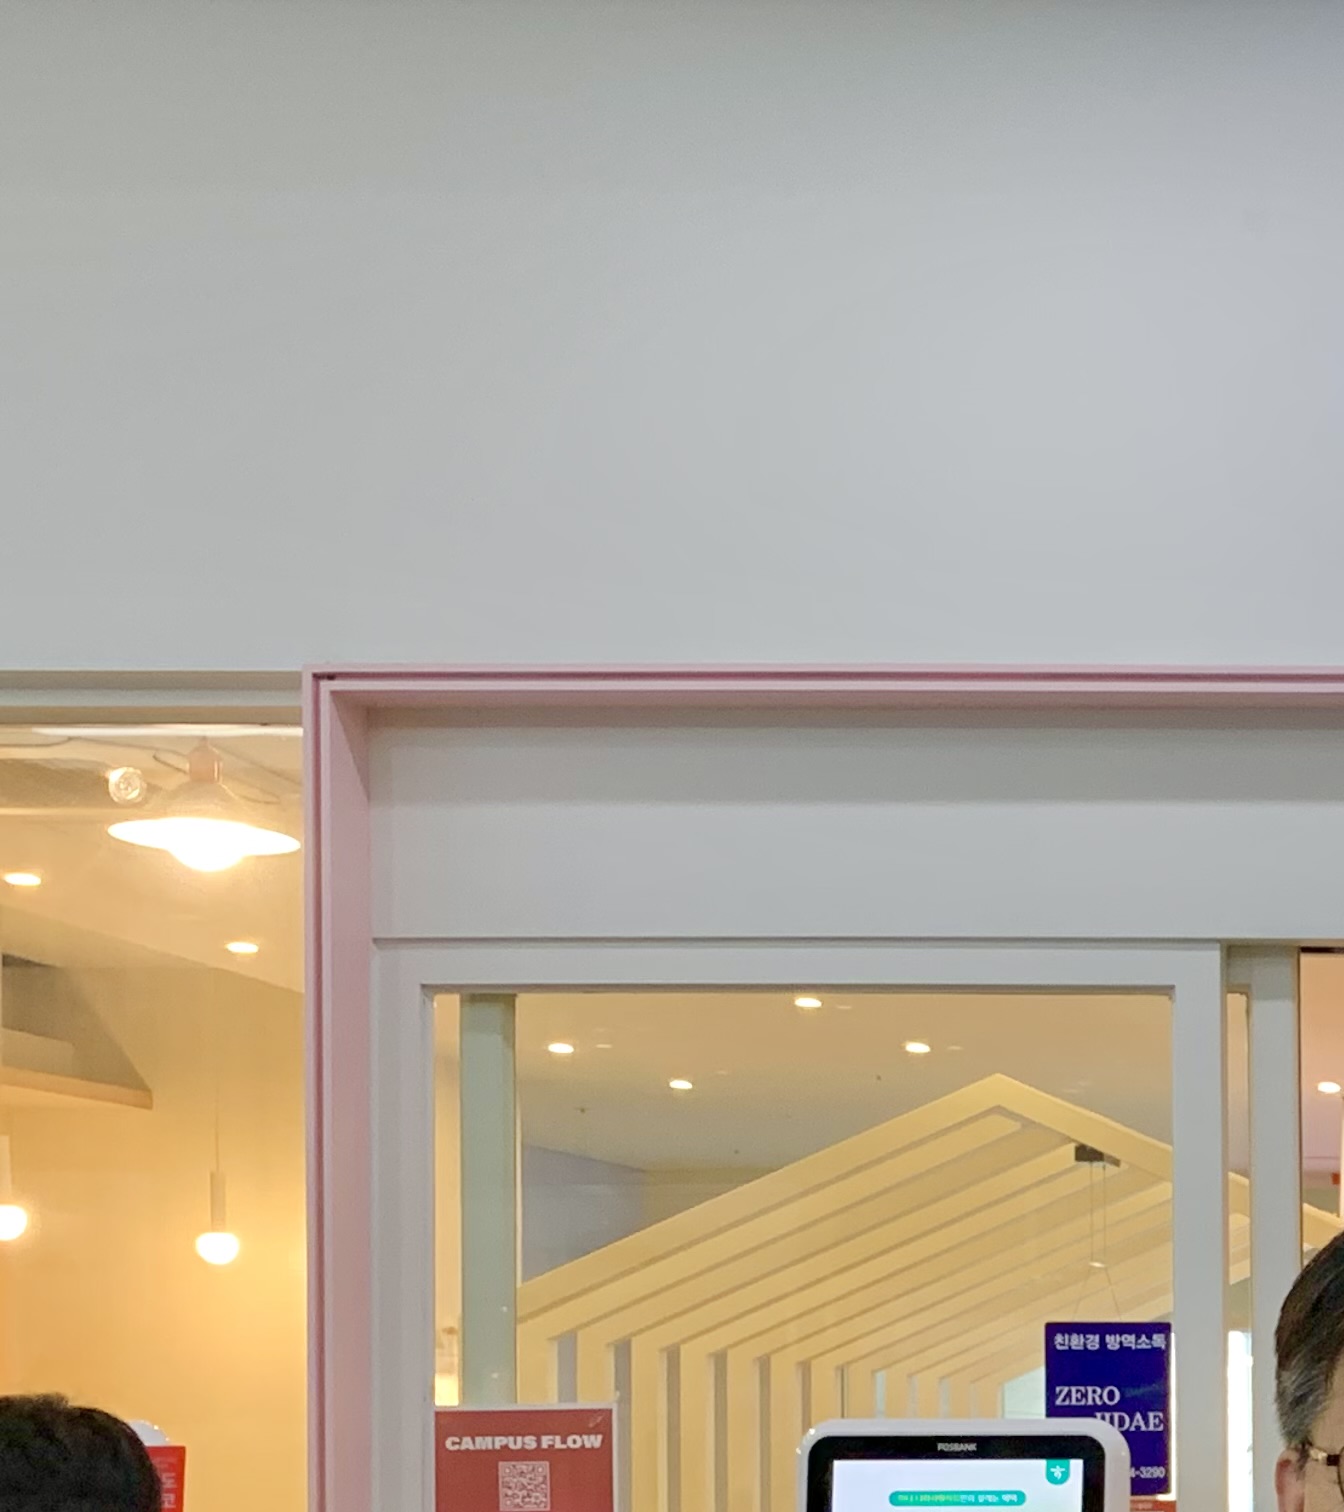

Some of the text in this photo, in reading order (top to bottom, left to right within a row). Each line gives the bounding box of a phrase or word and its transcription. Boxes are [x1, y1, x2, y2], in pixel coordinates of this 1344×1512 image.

[1054, 1333, 1167, 1351] 친환경 방역소독
[1055, 1386, 1121, 1406] ZERO
[445, 1434, 603, 1451] CAMPUS FLOW
